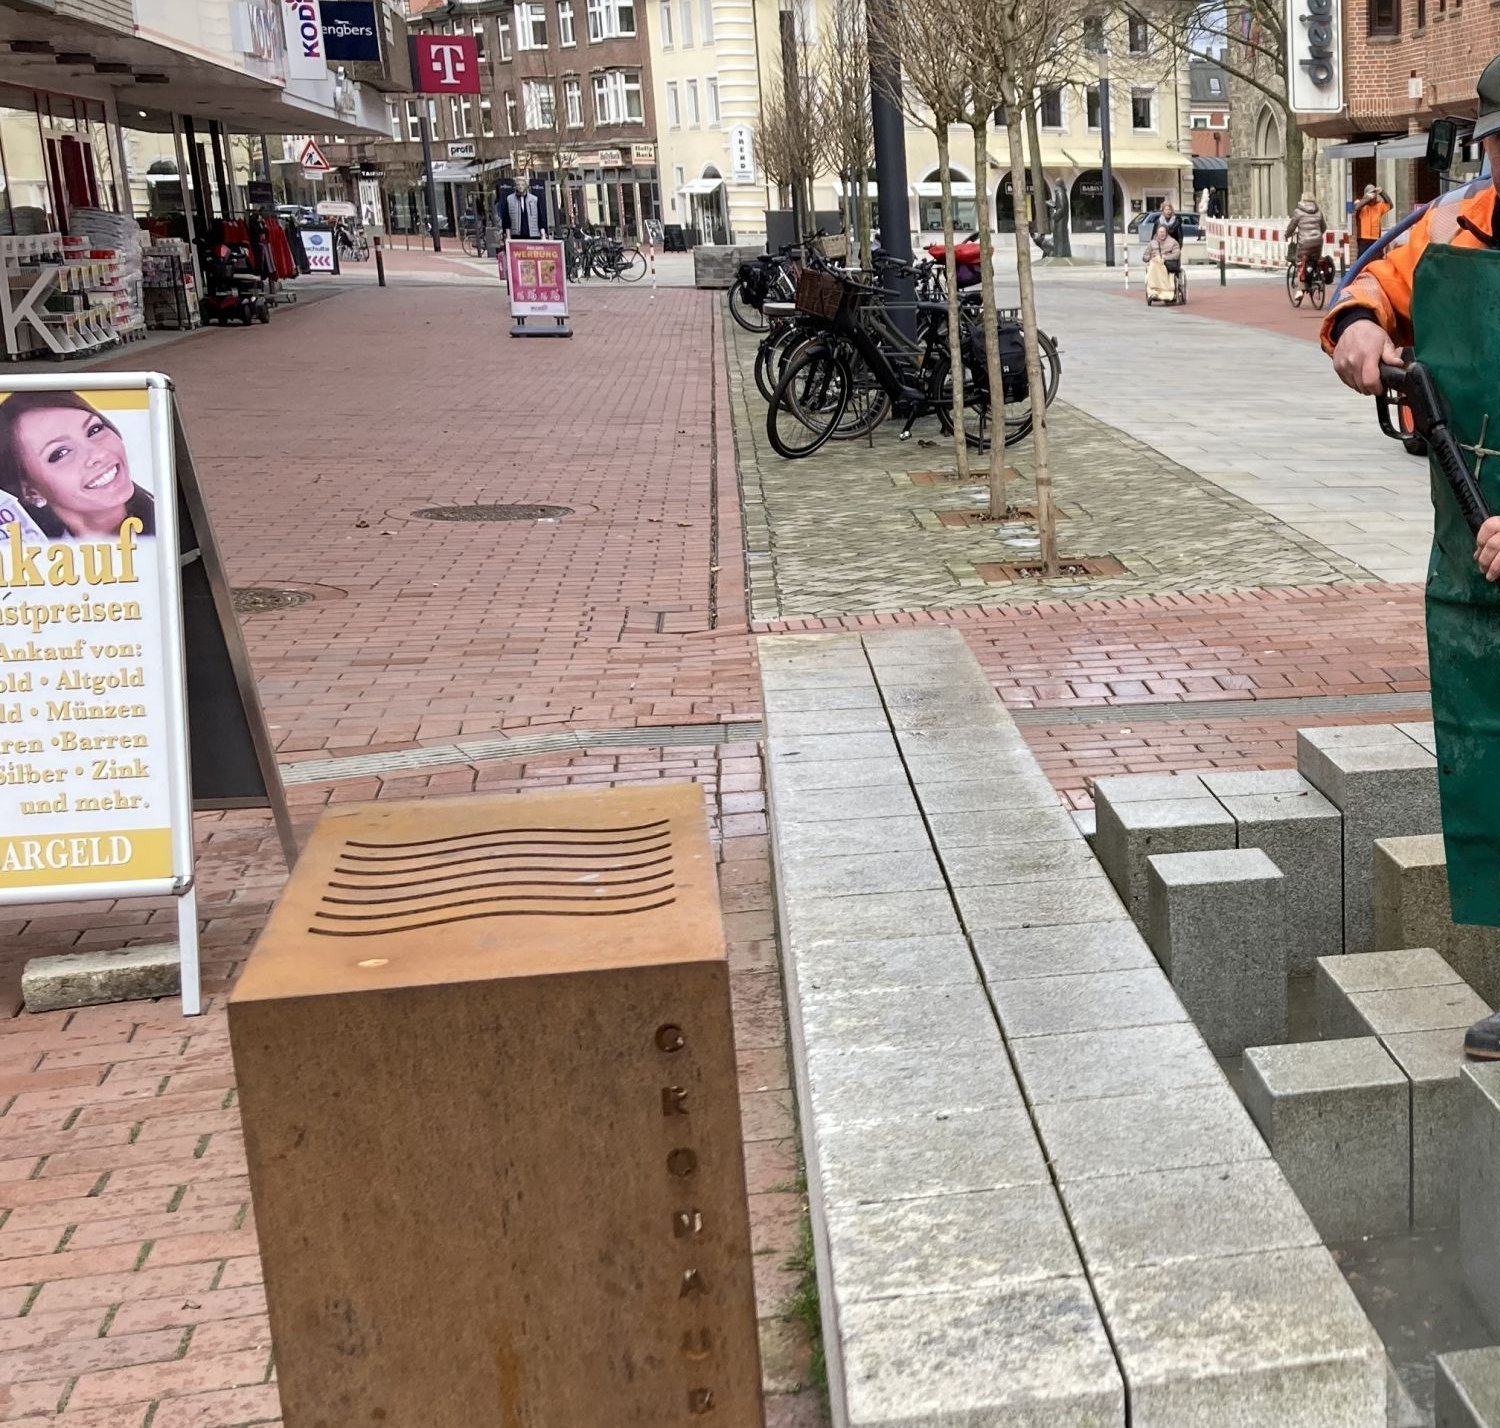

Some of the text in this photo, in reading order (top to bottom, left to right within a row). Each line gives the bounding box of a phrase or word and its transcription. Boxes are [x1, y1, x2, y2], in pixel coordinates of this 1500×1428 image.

[300, 0, 320, 58] KOD
[322, 26, 373, 37] engbers
[430, 44, 464, 84] T
[513, 250, 558, 258] WERBUNG
[0, 592, 143, 633] stpreisen
[90, 643, 143, 658] von:
[55, 666, 145, 695] Altgold
[45, 700, 147, 722] Münzen
[91, 758, 150, 780] Zink
[19, 789, 150, 815] und mehr.
